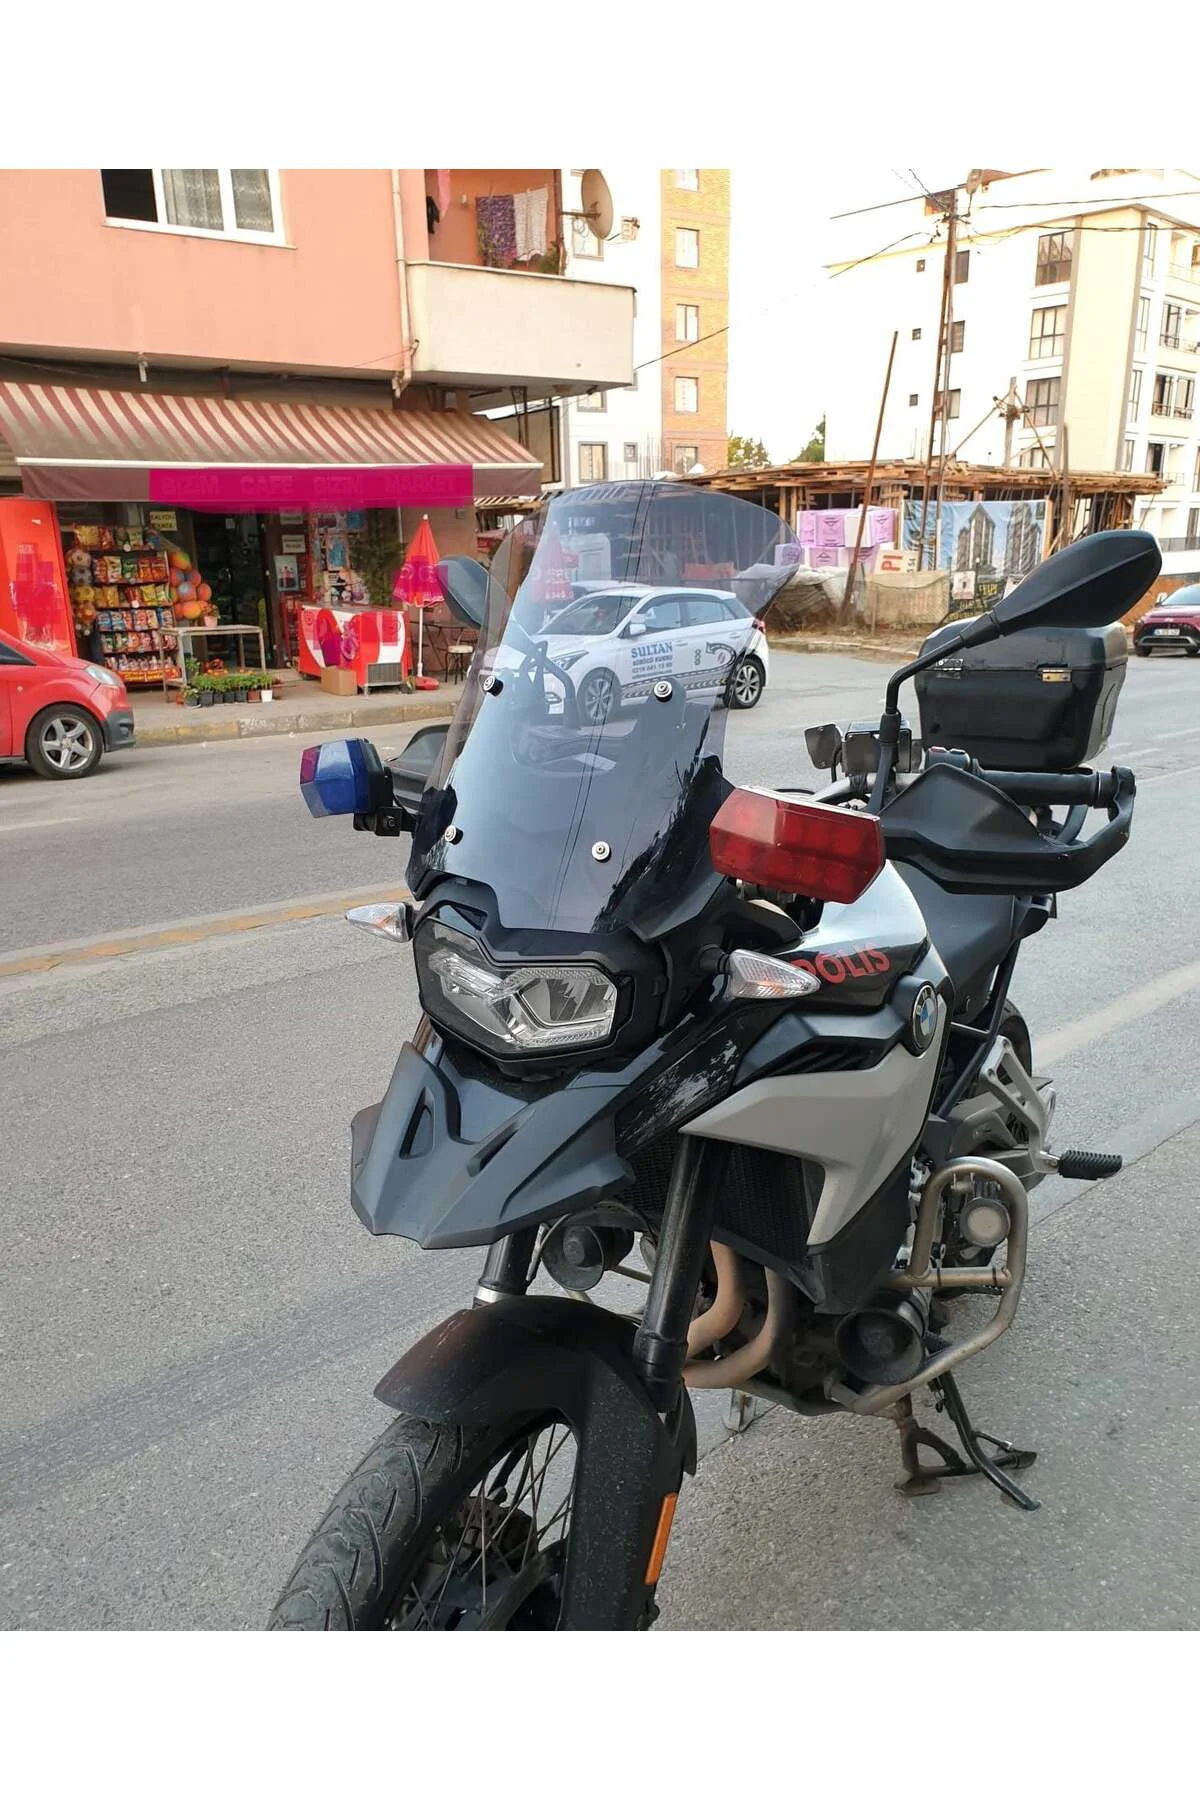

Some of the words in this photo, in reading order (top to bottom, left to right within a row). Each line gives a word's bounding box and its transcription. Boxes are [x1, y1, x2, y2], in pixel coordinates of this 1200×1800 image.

[240, 476, 295, 495] CAFE
[386, 475, 457, 494] MARKET
[632, 642, 672, 658] SULTAN
